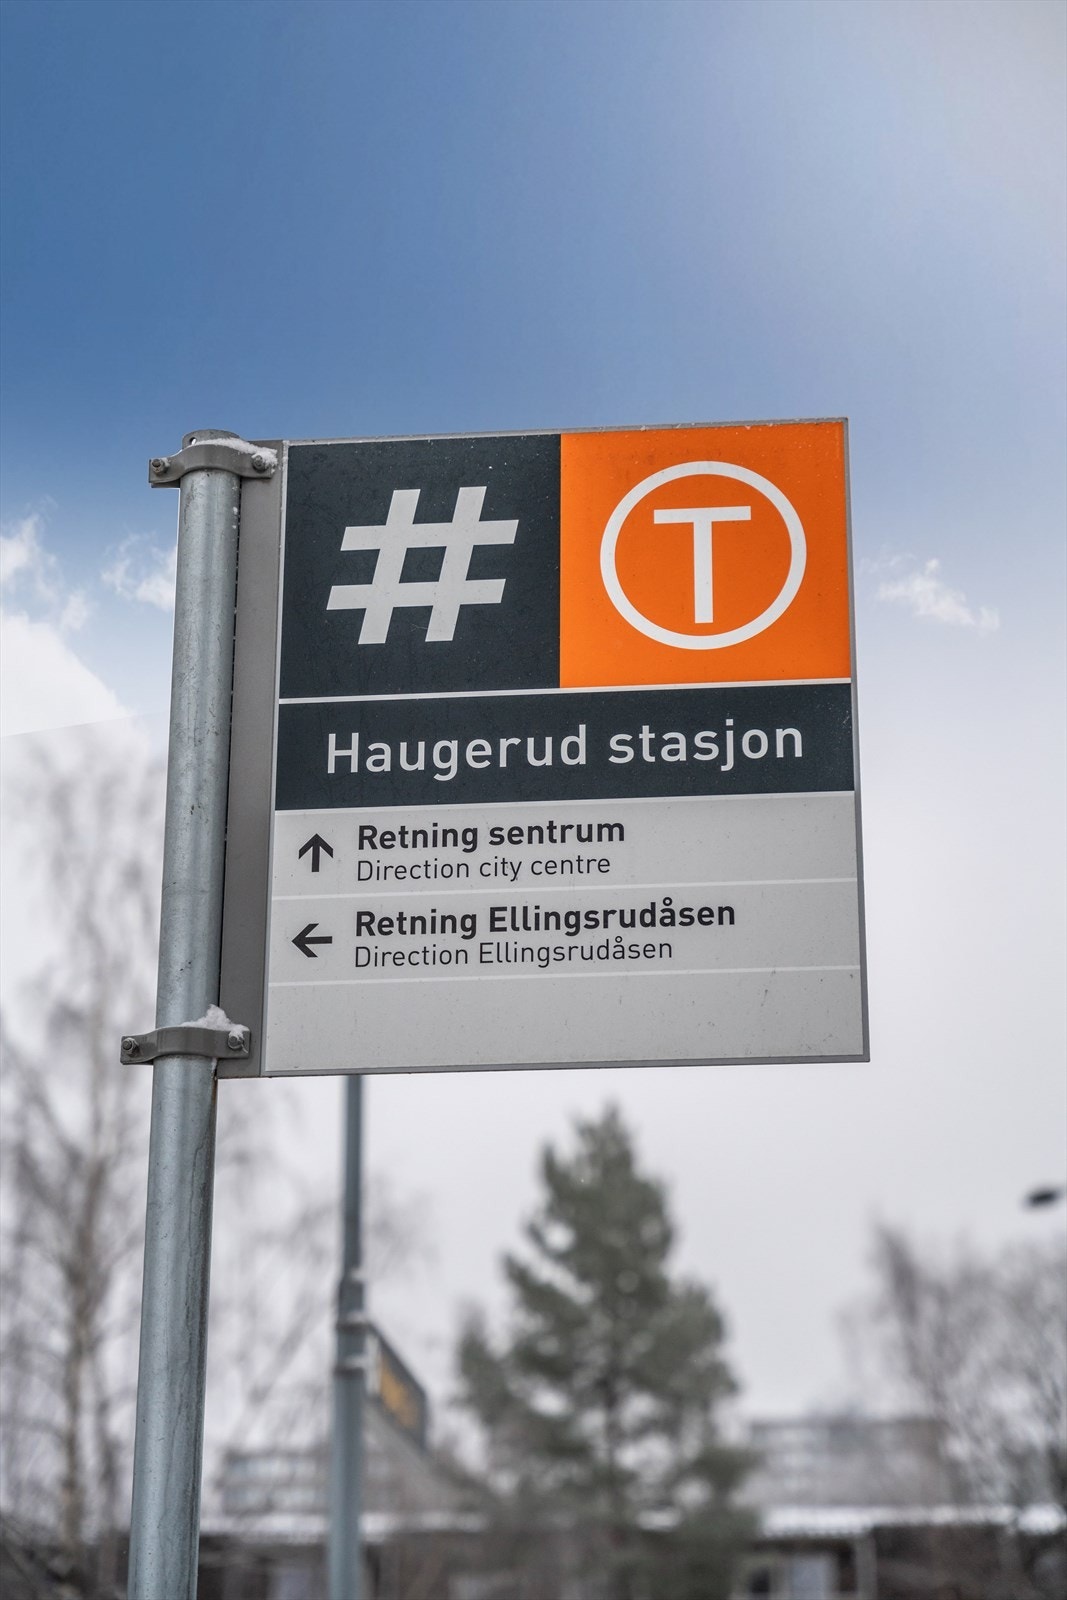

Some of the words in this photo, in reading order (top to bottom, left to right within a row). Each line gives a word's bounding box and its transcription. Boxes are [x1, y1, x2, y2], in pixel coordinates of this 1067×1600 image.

[653, 505, 752, 625] T
[326, 723, 588, 783] Haugerud
[608, 718, 804, 772] stasjon
[357, 822, 479, 855] Retning
[488, 820, 625, 846] sentrum
[356, 857, 470, 882] Direction
[479, 855, 523, 883] city
[530, 854, 612, 876] centre
[355, 907, 478, 940] Retning
[488, 896, 736, 937] Ellingsrudåsen
[354, 940, 470, 968] Direction
[478, 935, 673, 968] Ellingsrudåsen
